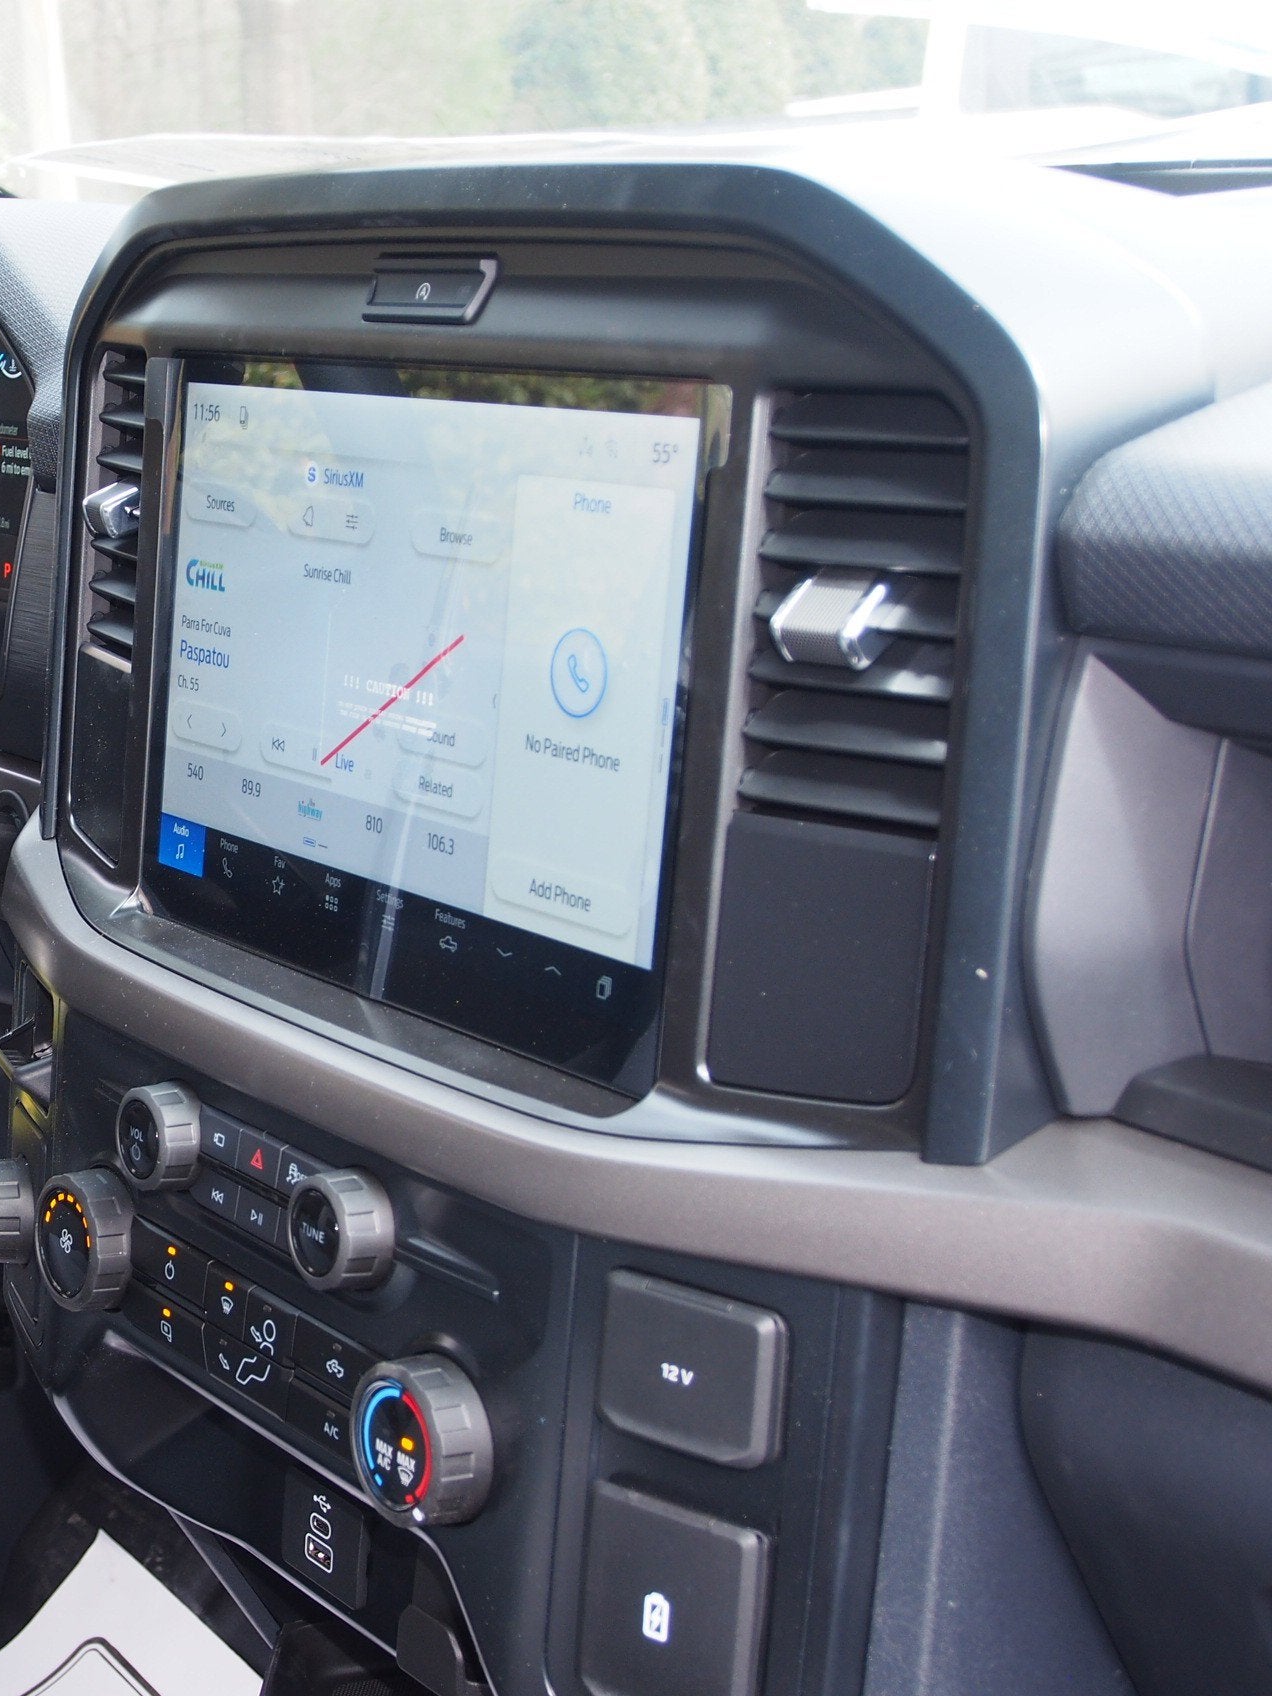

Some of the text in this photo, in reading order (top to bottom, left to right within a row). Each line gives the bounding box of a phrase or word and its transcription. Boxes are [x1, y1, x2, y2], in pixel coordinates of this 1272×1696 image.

[193, 402, 221, 422] 11:56
[1, 444, 29, 459] Fuel level
[652, 441, 679, 464] 55°
[0, 461, 6, 474] 6
[307, 466, 316, 482] S
[323, 468, 364, 488] SiriusXM
[206, 495, 235, 513] Sources
[572, 492, 613, 514] Phone
[439, 526, 474, 546] Browse
[4, 562, 12, 578] P
[186, 558, 226, 592] CHILL
[303, 563, 352, 585] Sunrise Chill
[181, 614, 232, 638] Parra For Cuva
[180, 639, 230, 669] Paspatou
[177, 674, 200, 692] Ch. 55
[366, 679, 411, 701] CAUTION
[525, 733, 621, 772] No Paired Phone
[186, 762, 204, 781] 540
[334, 754, 355, 772] Live
[241, 778, 262, 798] 89.9
[418, 775, 454, 798] Related
[172, 822, 190, 838] Audio
[365, 814, 383, 834] 810
[220, 837, 239, 854] Phone
[427, 832, 455, 856] 106.3
[273, 855, 287, 870] Fav
[324, 872, 342, 889] Apps
[375, 889, 404, 910] Settings
[529, 878, 592, 912] Add Phone
[434, 908, 466, 930] Features
[129, 1125, 144, 1143] VOL
[301, 1221, 326, 1245] TUNE
[323, 1421, 340, 1440] A/C
[374, 1437, 394, 1460] MAX
[376, 1452, 392, 1471] A/C
